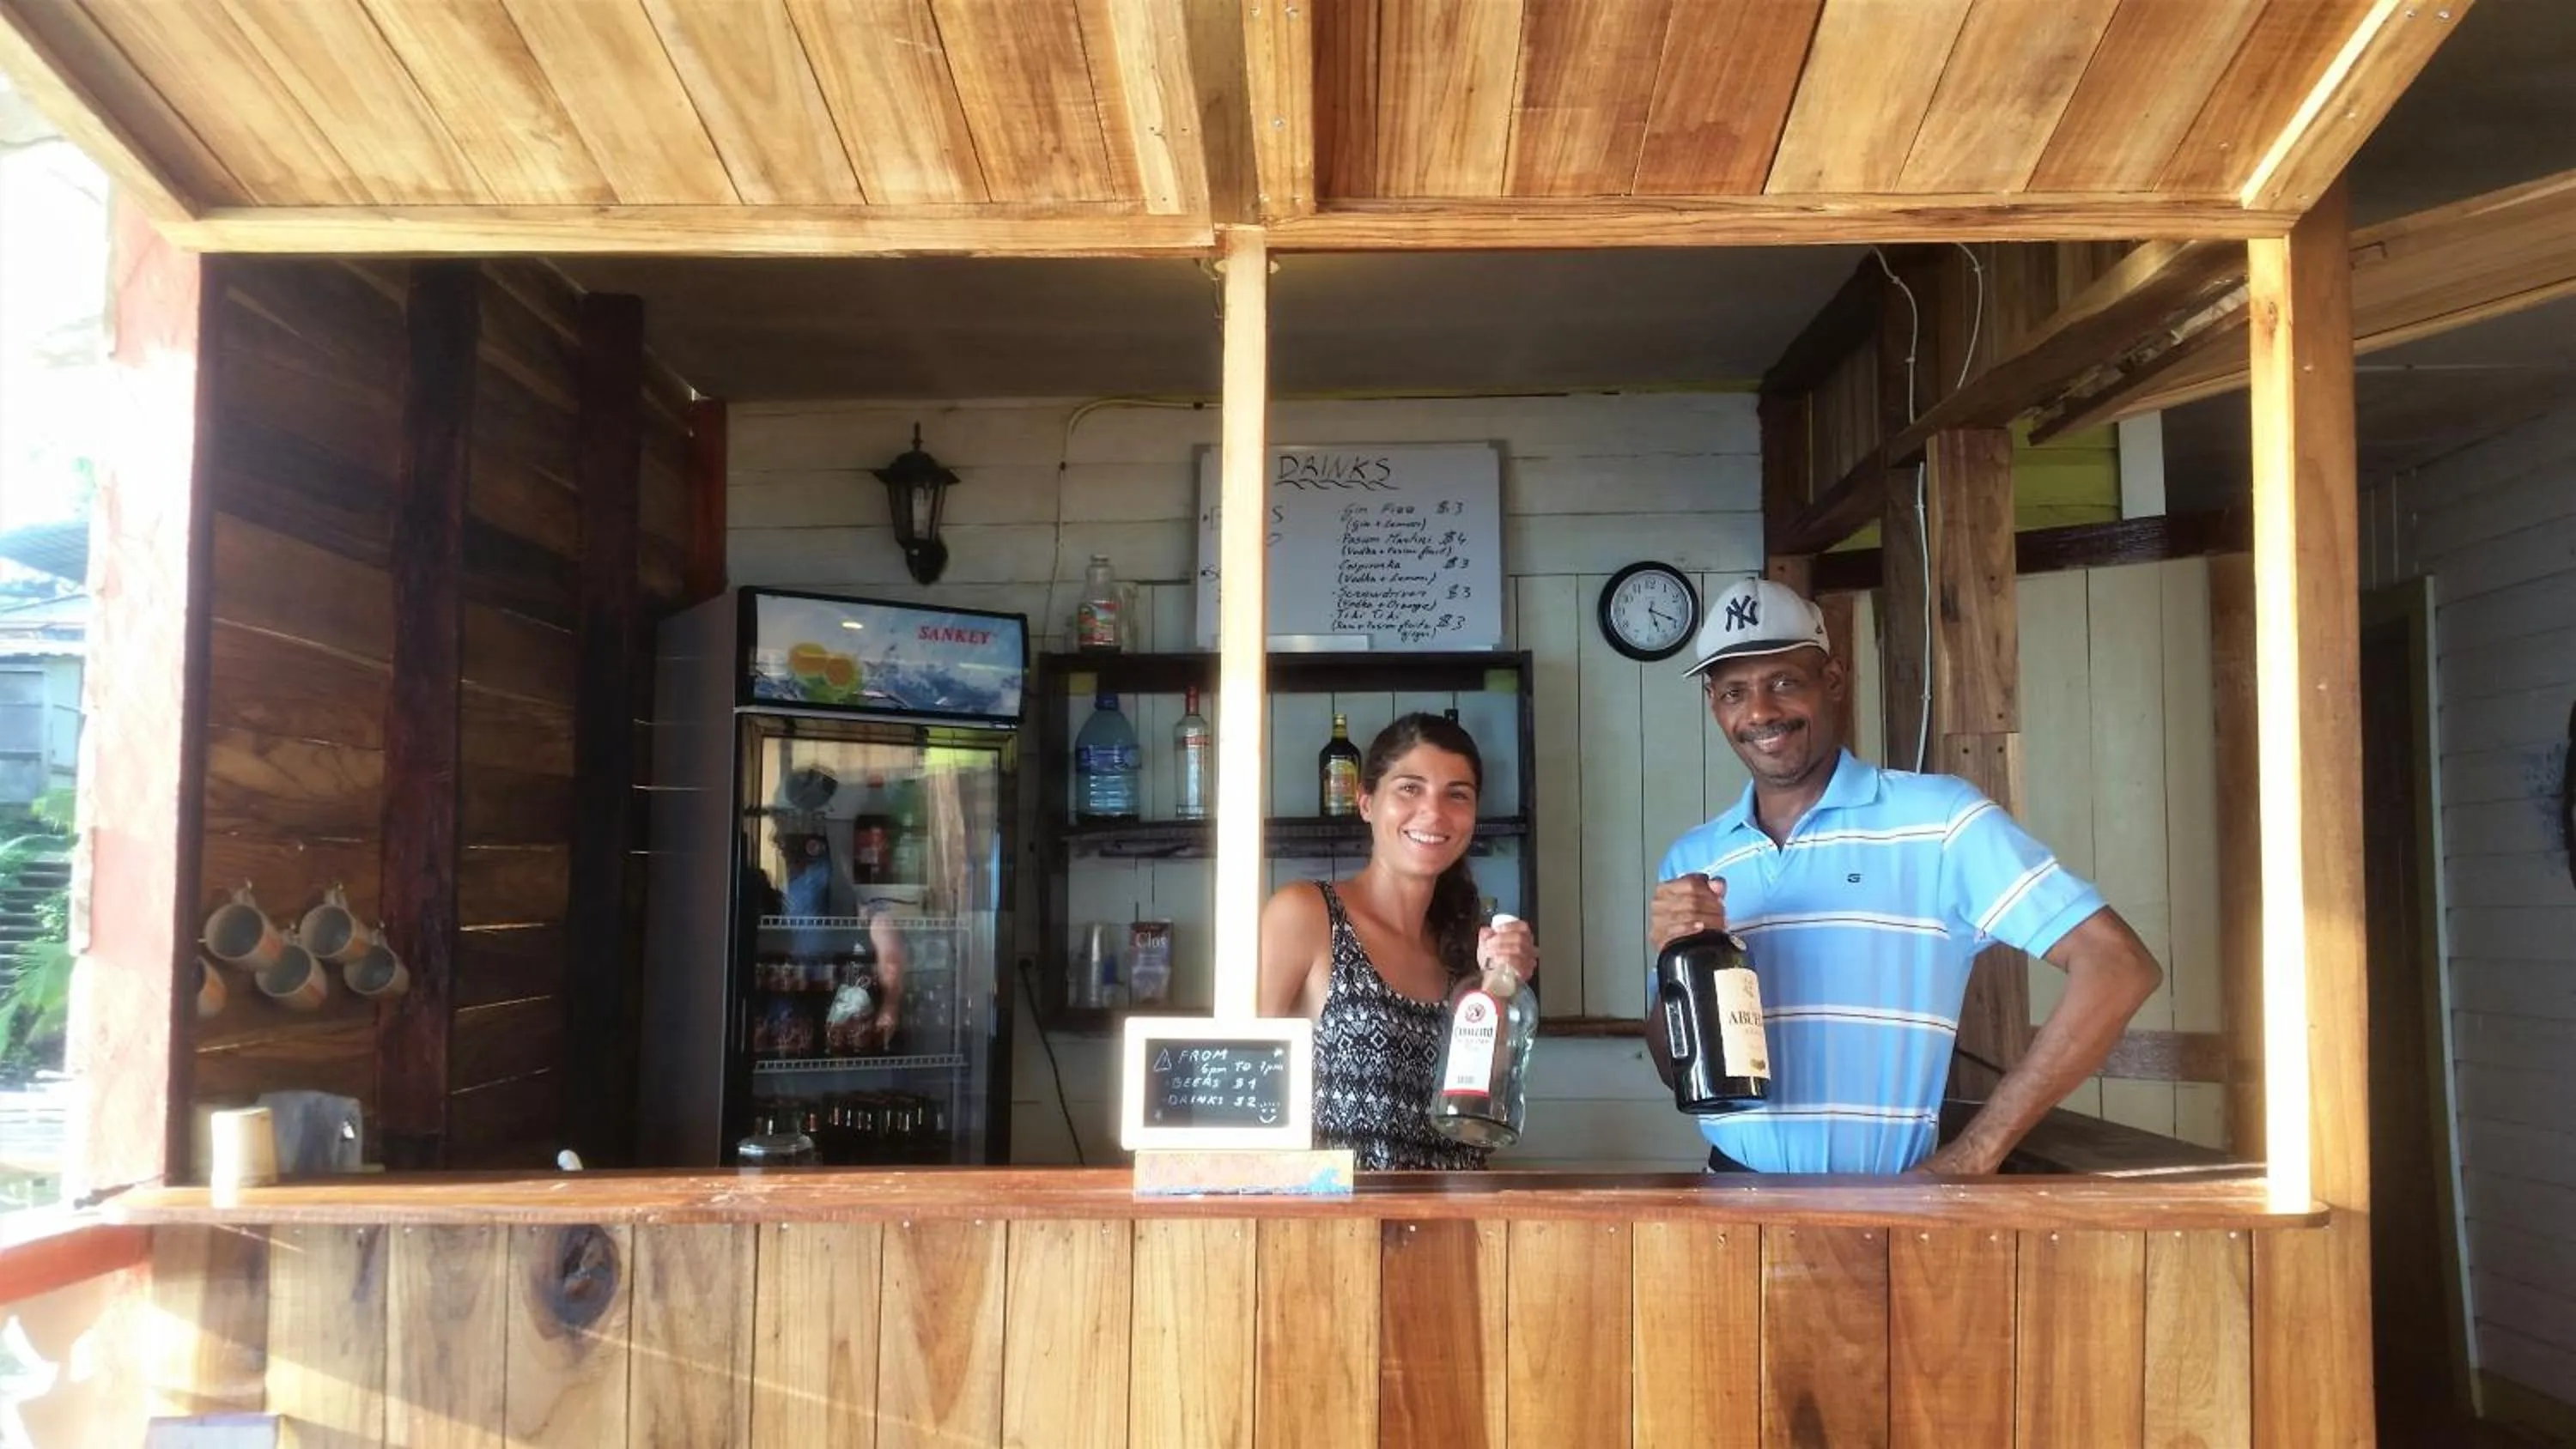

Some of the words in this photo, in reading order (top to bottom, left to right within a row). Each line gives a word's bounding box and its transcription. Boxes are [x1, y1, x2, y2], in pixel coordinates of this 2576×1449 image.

[1278, 455, 1392, 481] DRINKS
[1725, 595, 1759, 632] NY
[918, 625, 991, 645] SANKEY
[1178, 1047, 1229, 1064] FROM
[1235, 1061, 1252, 1072] TO
[1168, 1094, 1224, 1106] DRINKS
